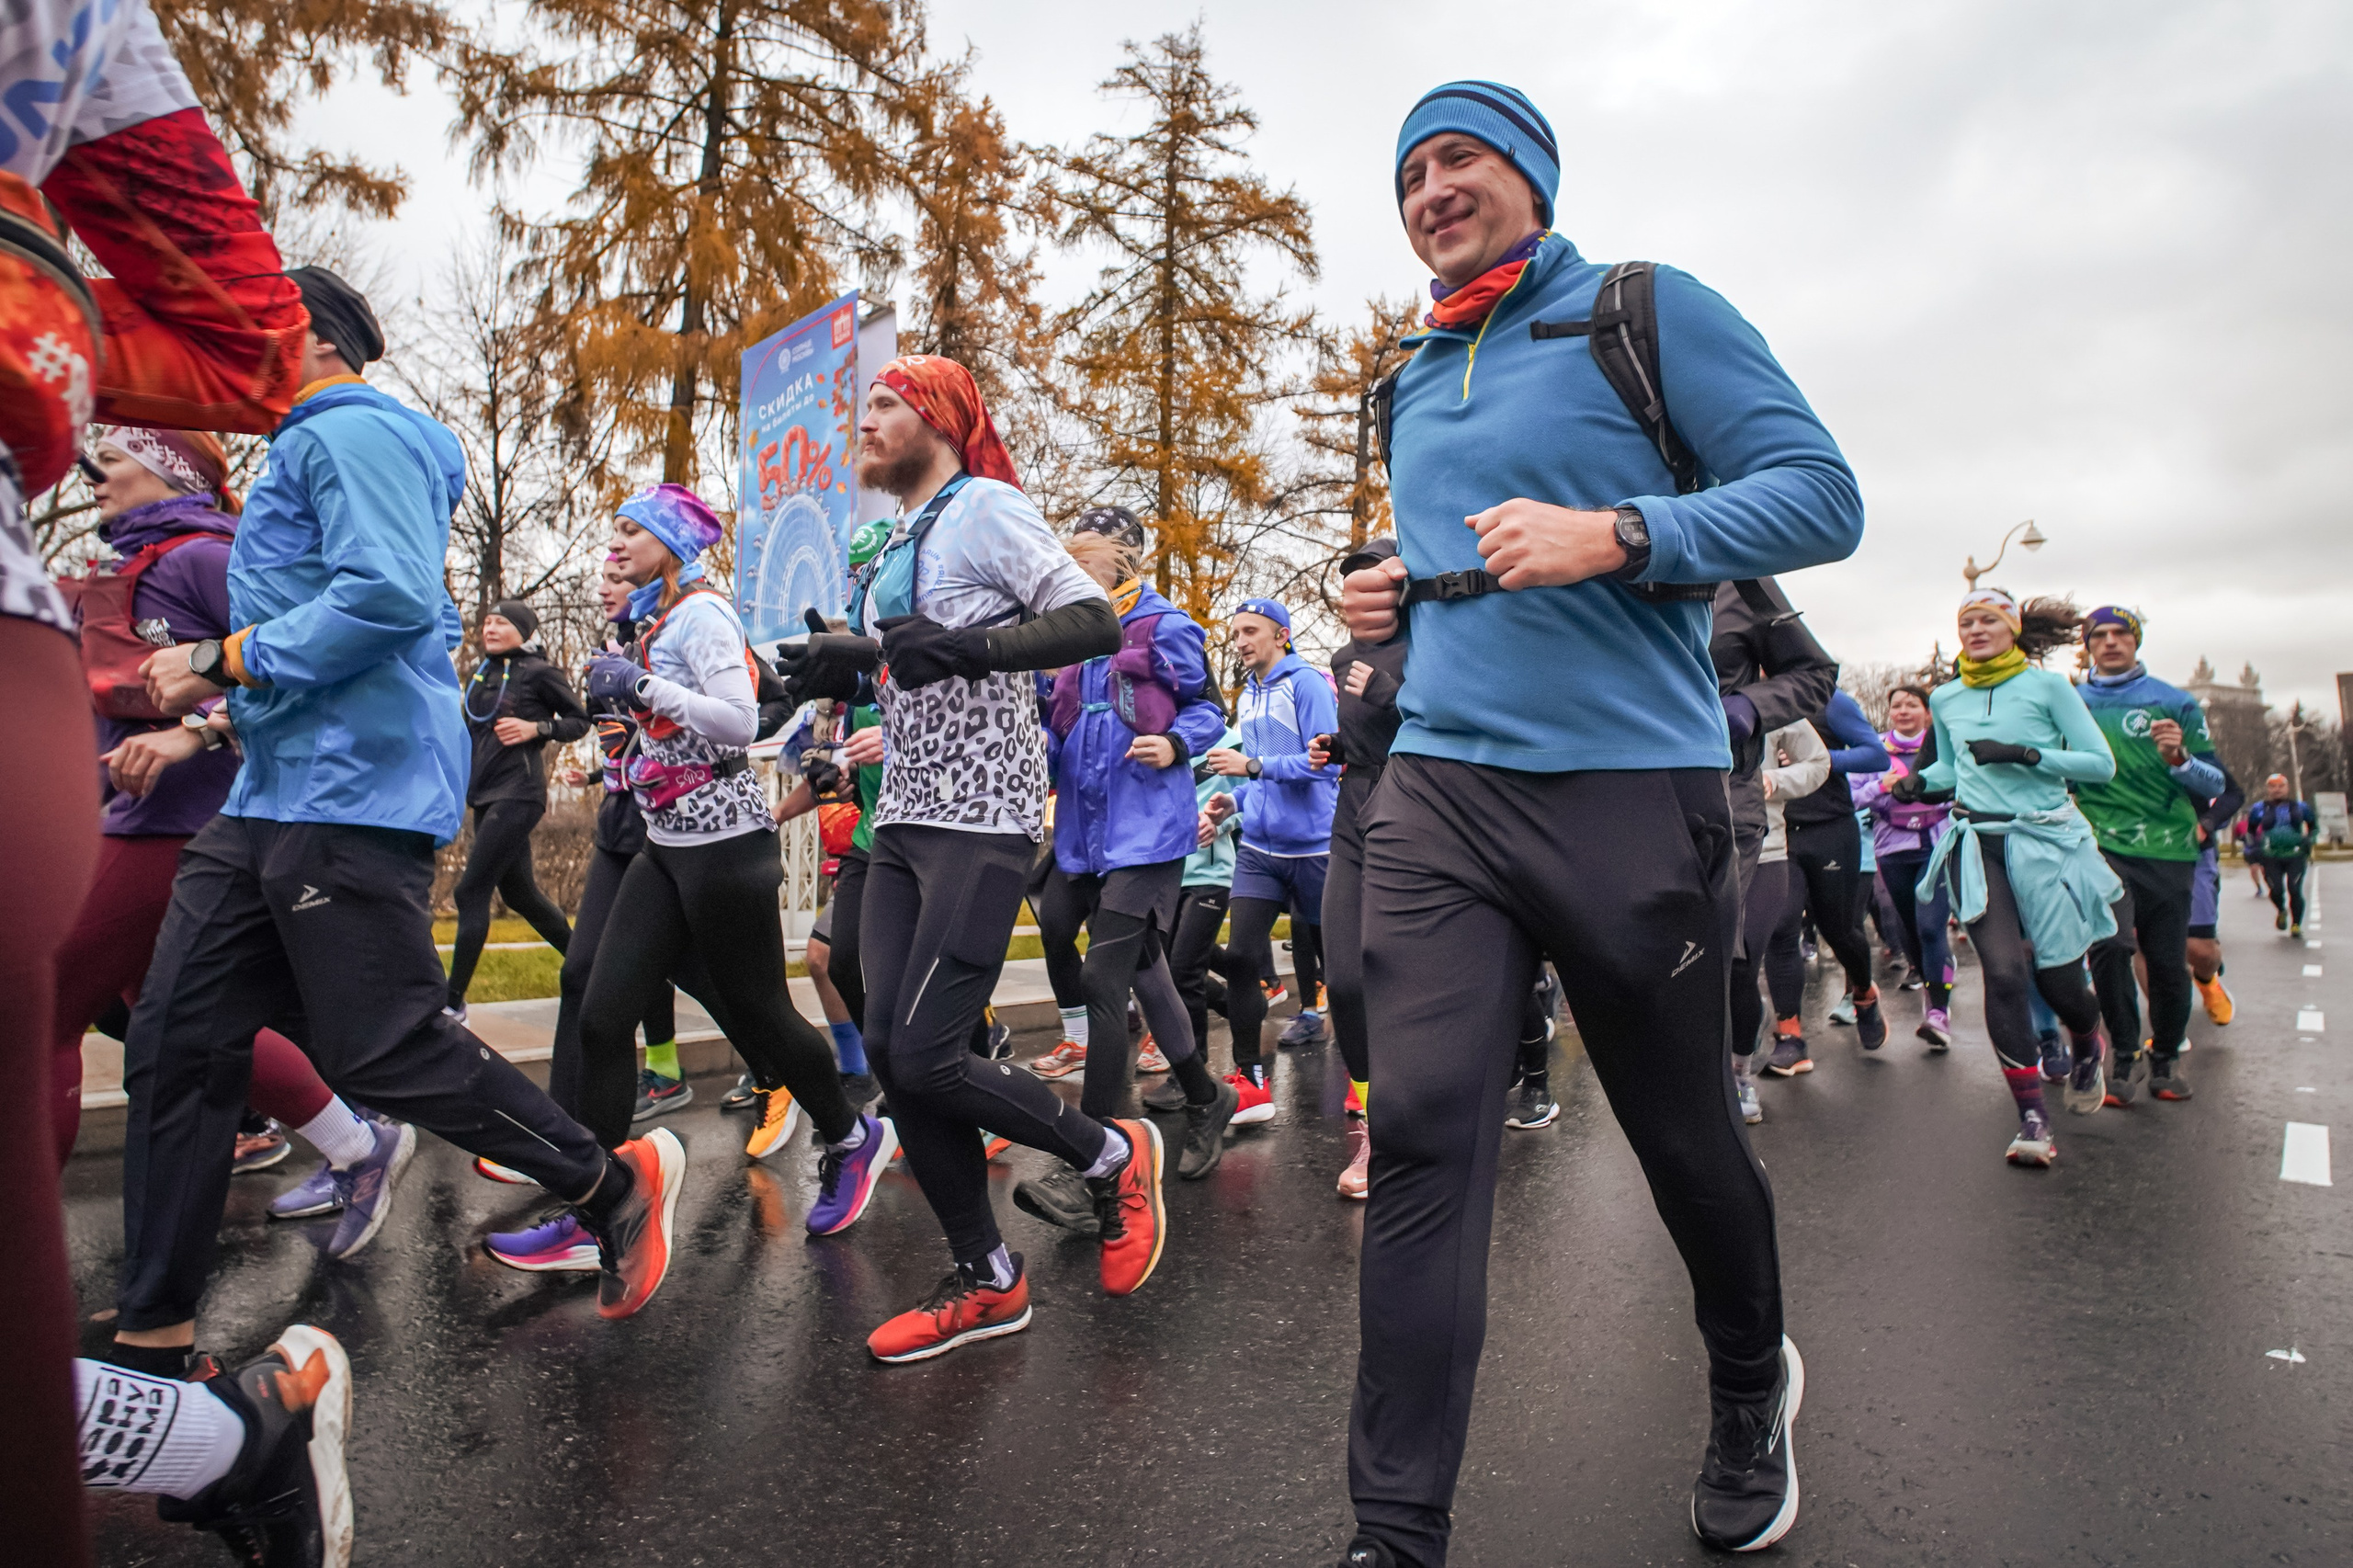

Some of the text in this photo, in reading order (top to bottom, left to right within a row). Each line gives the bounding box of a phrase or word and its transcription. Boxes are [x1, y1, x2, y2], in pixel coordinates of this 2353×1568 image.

[758, 371, 814, 420] СКИДКА
[761, 393, 815, 434] на билеты до
[757, 425, 832, 510] 50%
[1671, 949, 1705, 978] DEMIX
